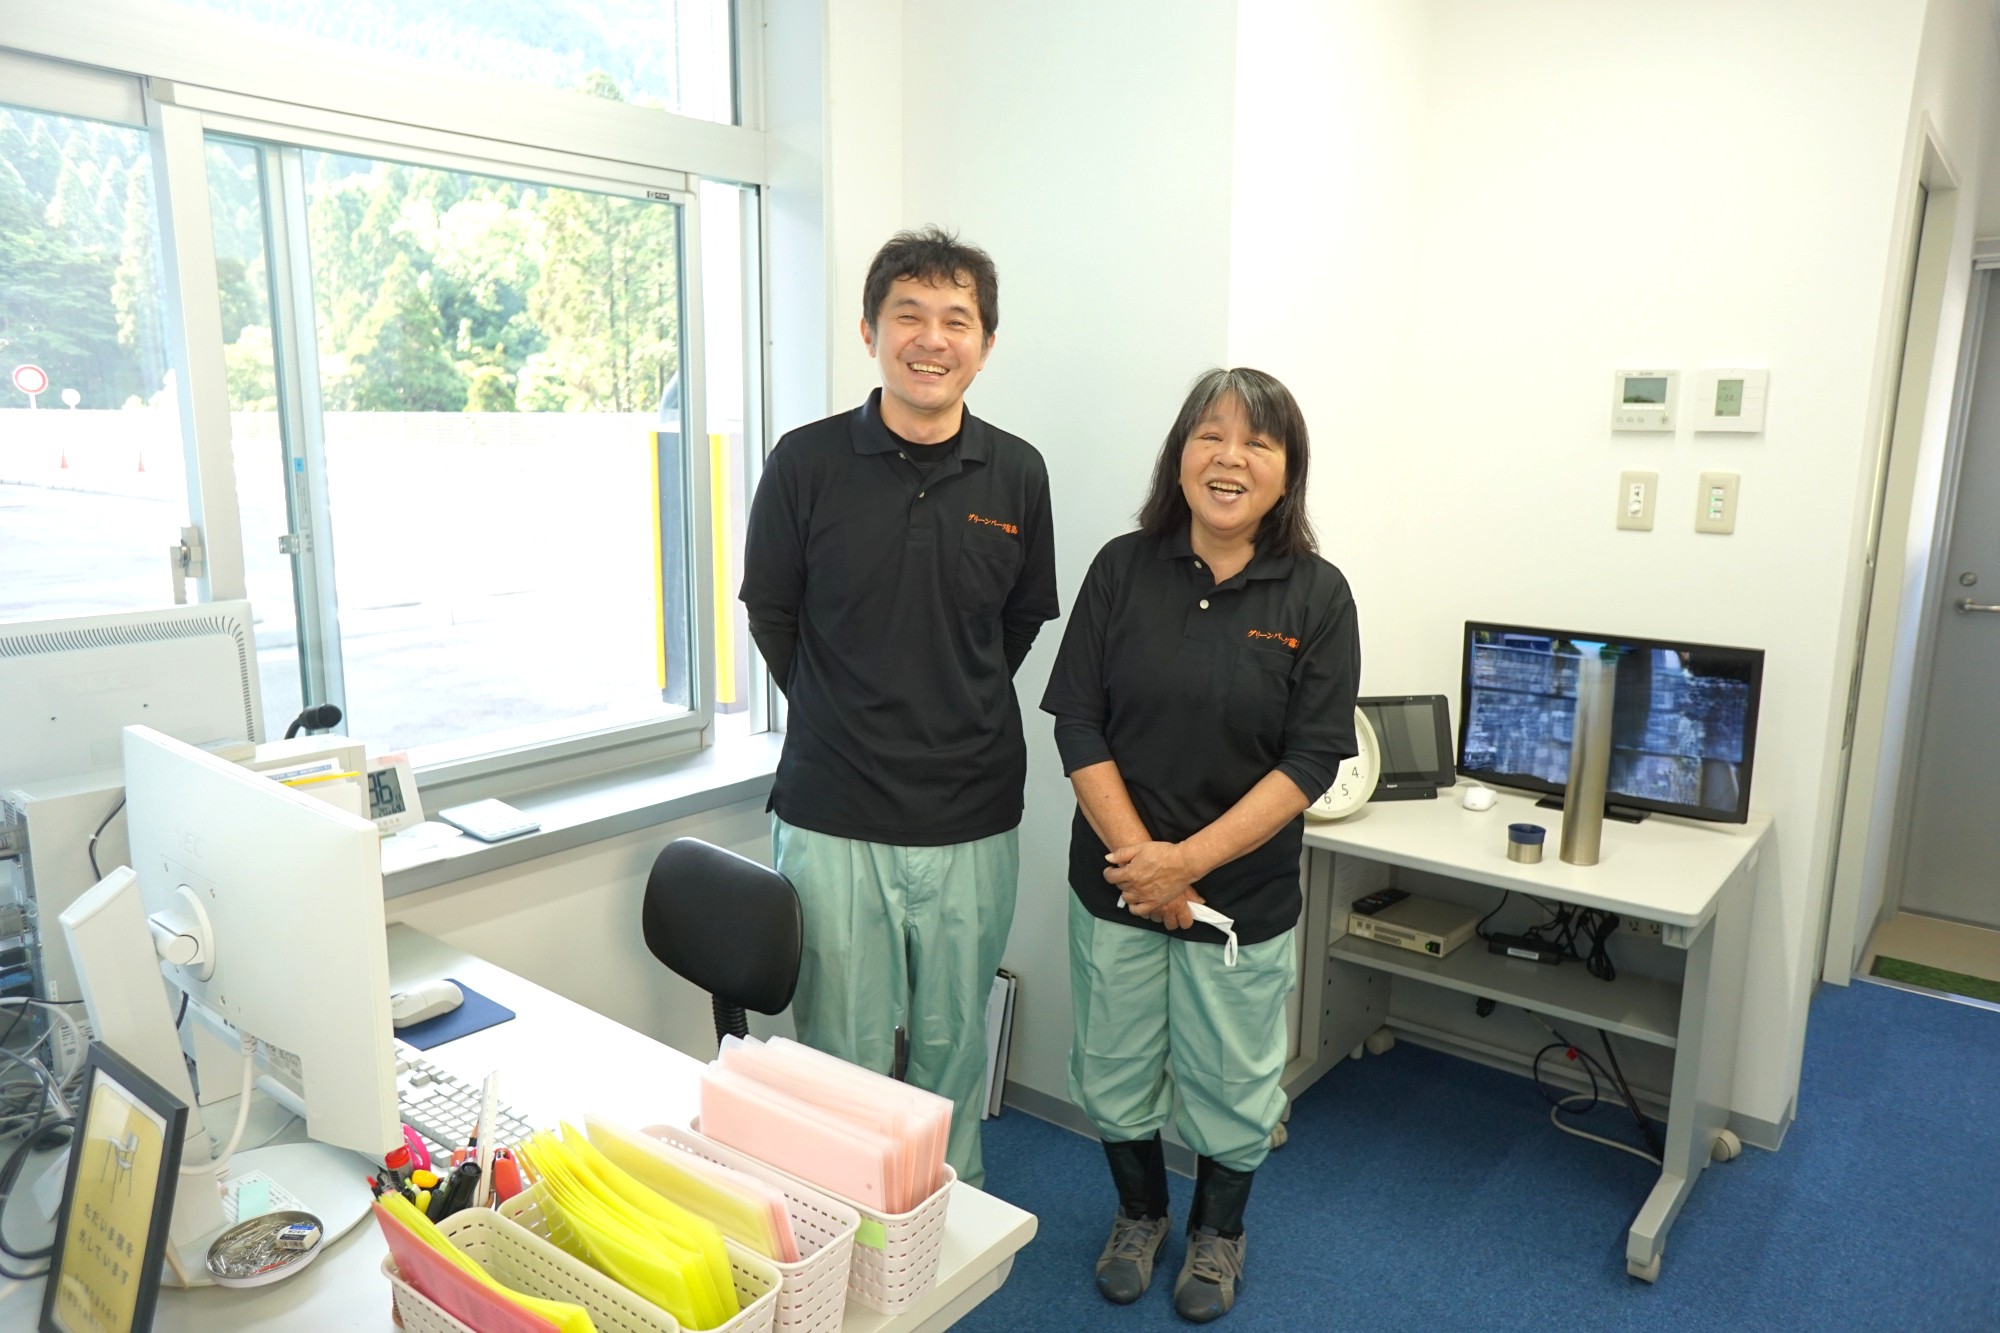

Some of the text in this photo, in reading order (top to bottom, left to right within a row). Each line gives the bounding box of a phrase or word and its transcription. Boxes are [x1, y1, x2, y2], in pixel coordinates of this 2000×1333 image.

[1351, 766, 1359, 778] 4
[1341, 784, 1349, 796] 5
[1324, 791, 1332, 804] 6
